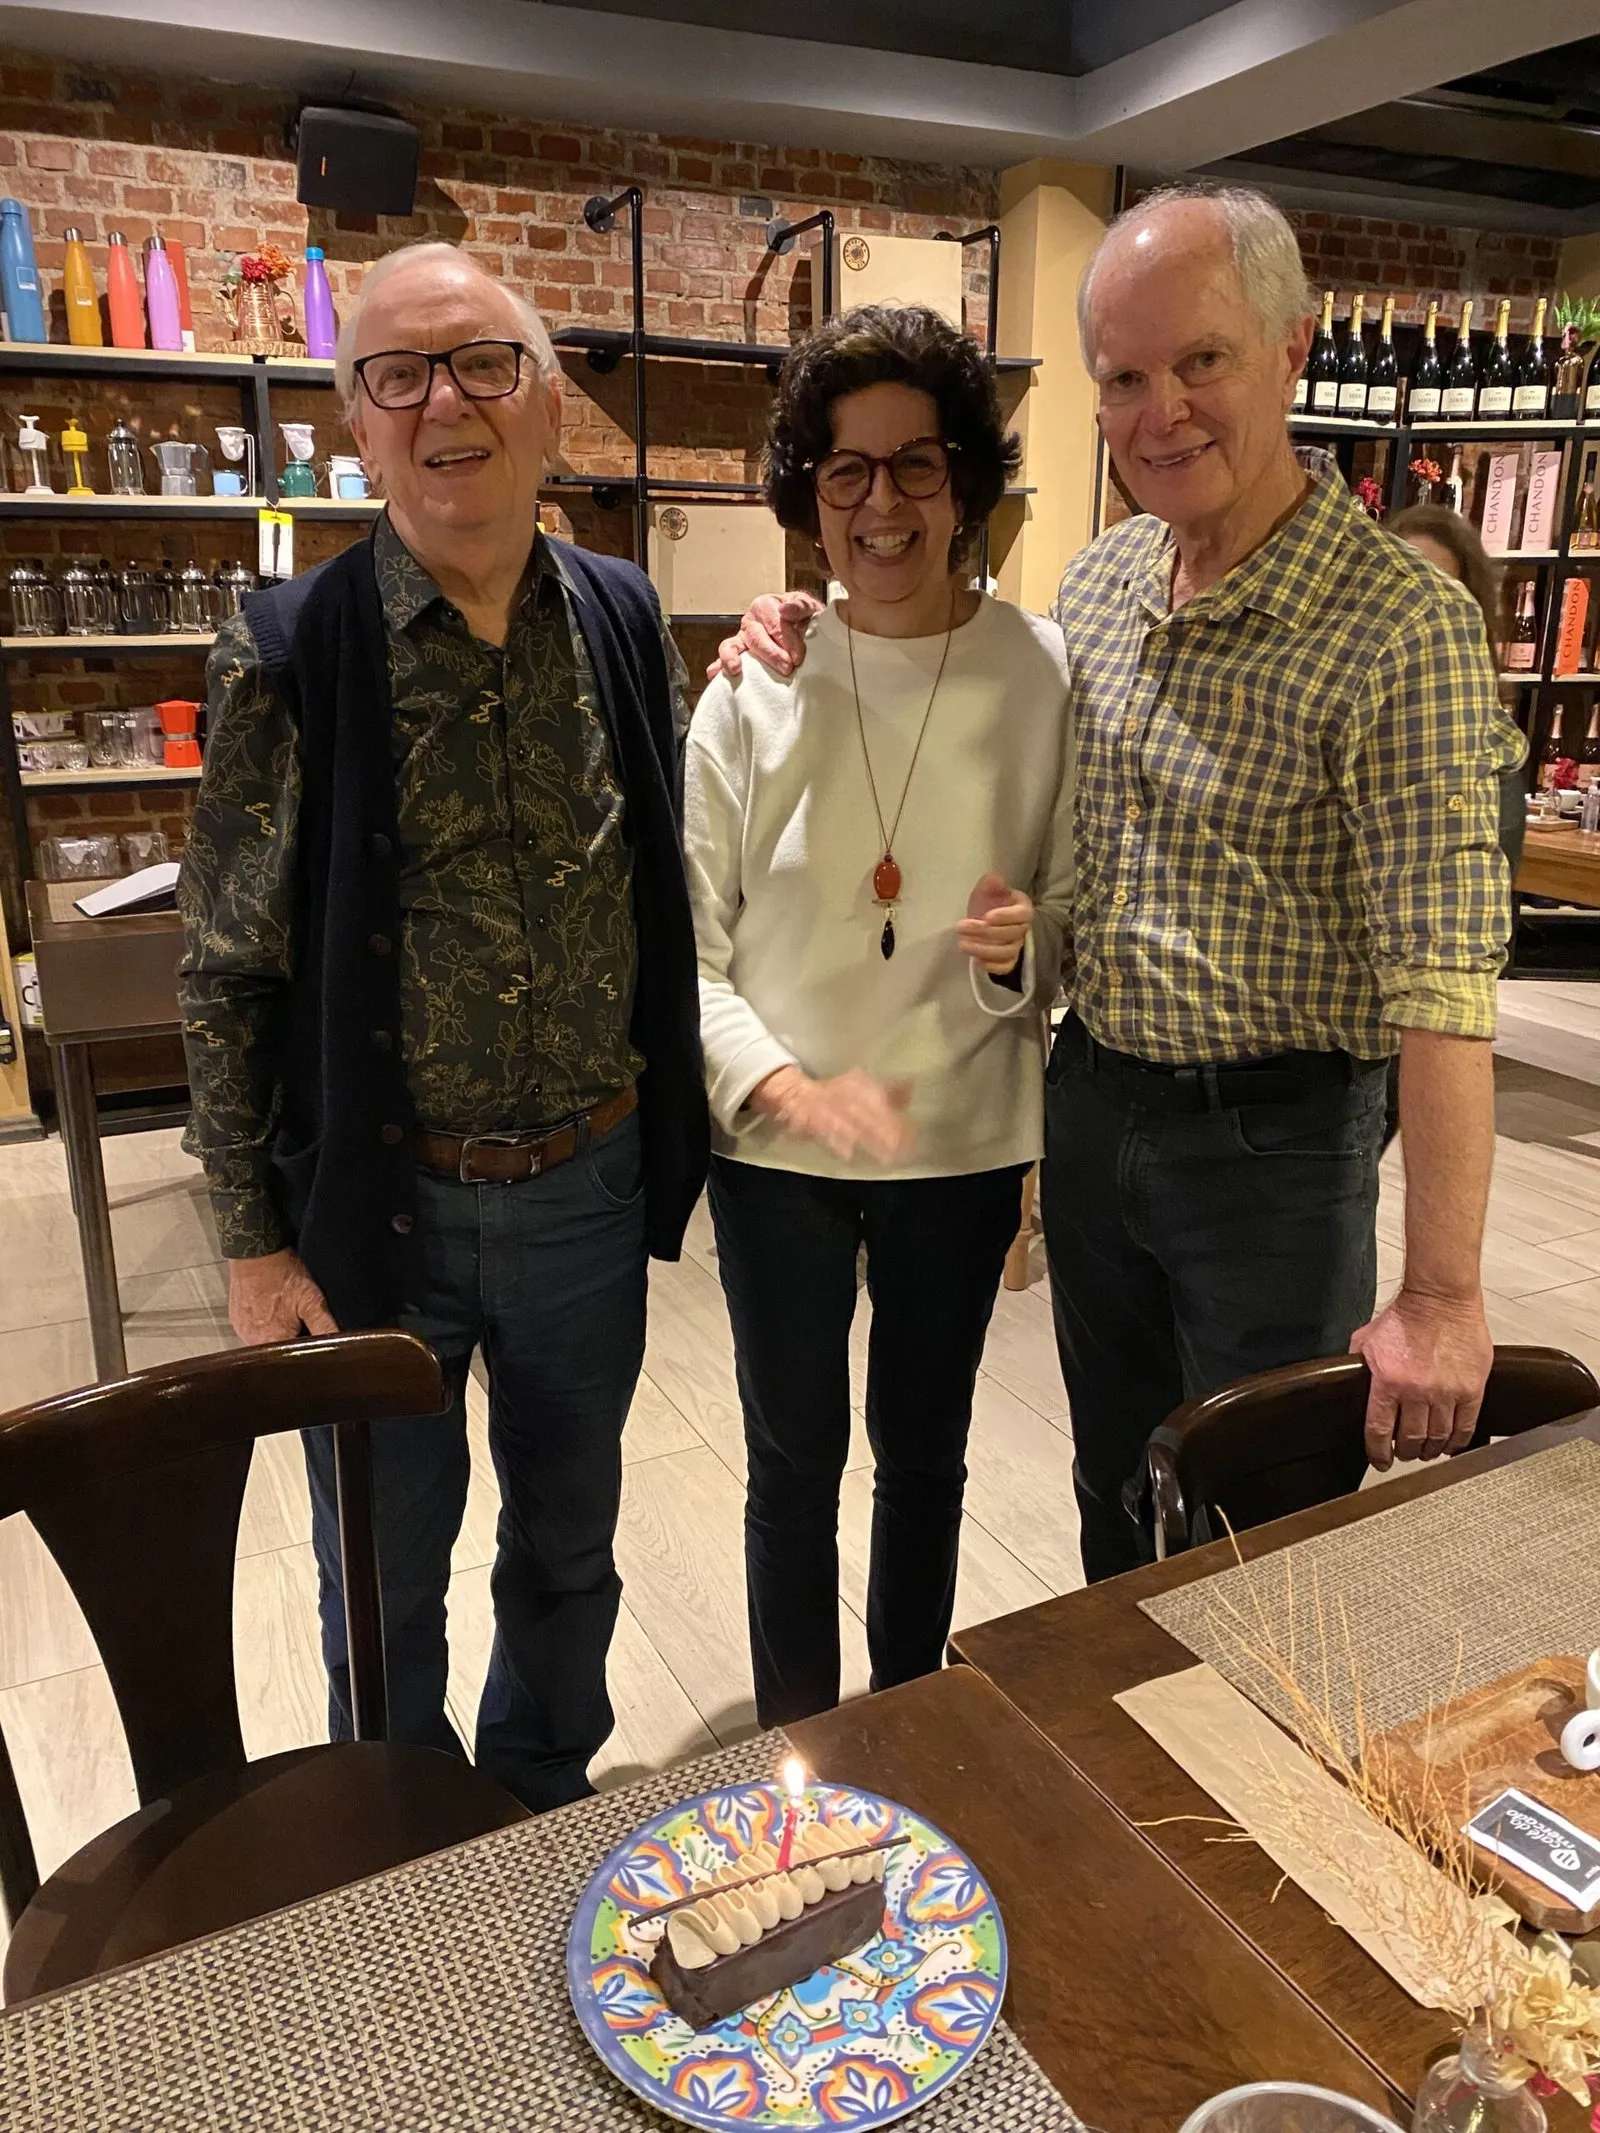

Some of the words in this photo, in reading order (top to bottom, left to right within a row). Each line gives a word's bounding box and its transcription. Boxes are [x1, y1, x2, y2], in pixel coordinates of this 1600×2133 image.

[1486, 455, 1505, 534] CHANDON
[1529, 454, 1548, 533] CHANDON
[1563, 581, 1581, 658] CHANDON
[1506, 1809, 1576, 1849] mercado
[1509, 1819, 1531, 1831] do
[1526, 1828, 1561, 1848] café
